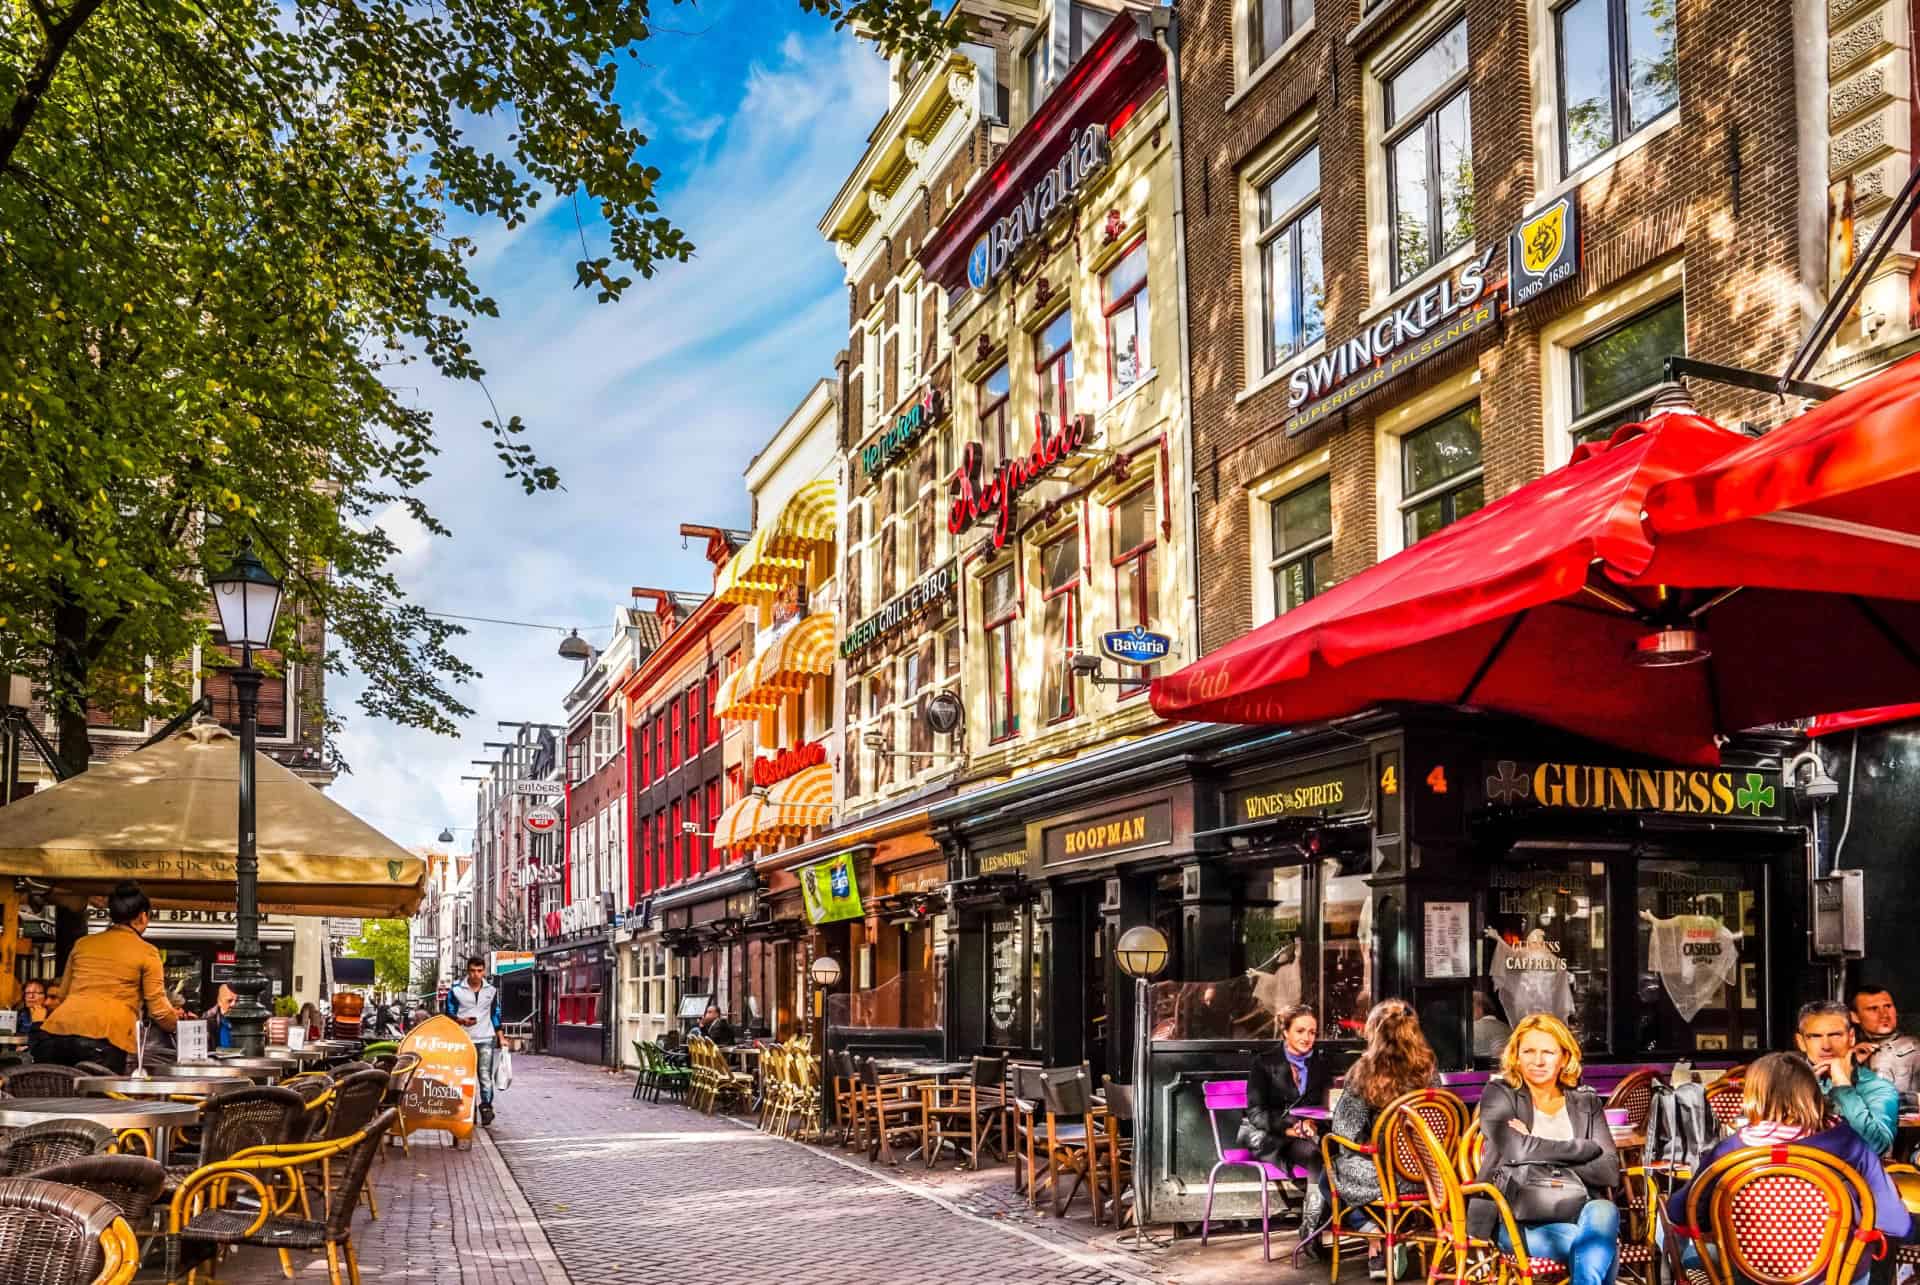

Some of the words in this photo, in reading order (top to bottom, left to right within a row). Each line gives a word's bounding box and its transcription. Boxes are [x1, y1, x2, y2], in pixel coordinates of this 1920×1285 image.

[990, 123, 1108, 277] Bavaria
[1518, 278, 1543, 301] SINDS
[1549, 262, 1570, 284] 1680
[1288, 246, 1495, 407] SWINCKELS'
[1289, 368, 1385, 431] SUPERIEUR
[1391, 308, 1490, 374] PILSENER
[863, 403, 920, 473] Heineken
[844, 616, 876, 655] GREEN
[879, 596, 909, 631] GRILL
[922, 568, 947, 605] BBQ
[1112, 638, 1164, 654] Bavaria
[1187, 660, 1231, 704] Pub
[1380, 766, 1397, 794] 4
[1427, 765, 1448, 793] 4
[1533, 761, 1735, 815] GUINNESS
[1246, 793, 1284, 819] WINES
[1294, 781, 1343, 809] SPIRITS
[1065, 816, 1145, 854] HOOPMAN
[1505, 957, 1568, 970] CAFFREY'S
